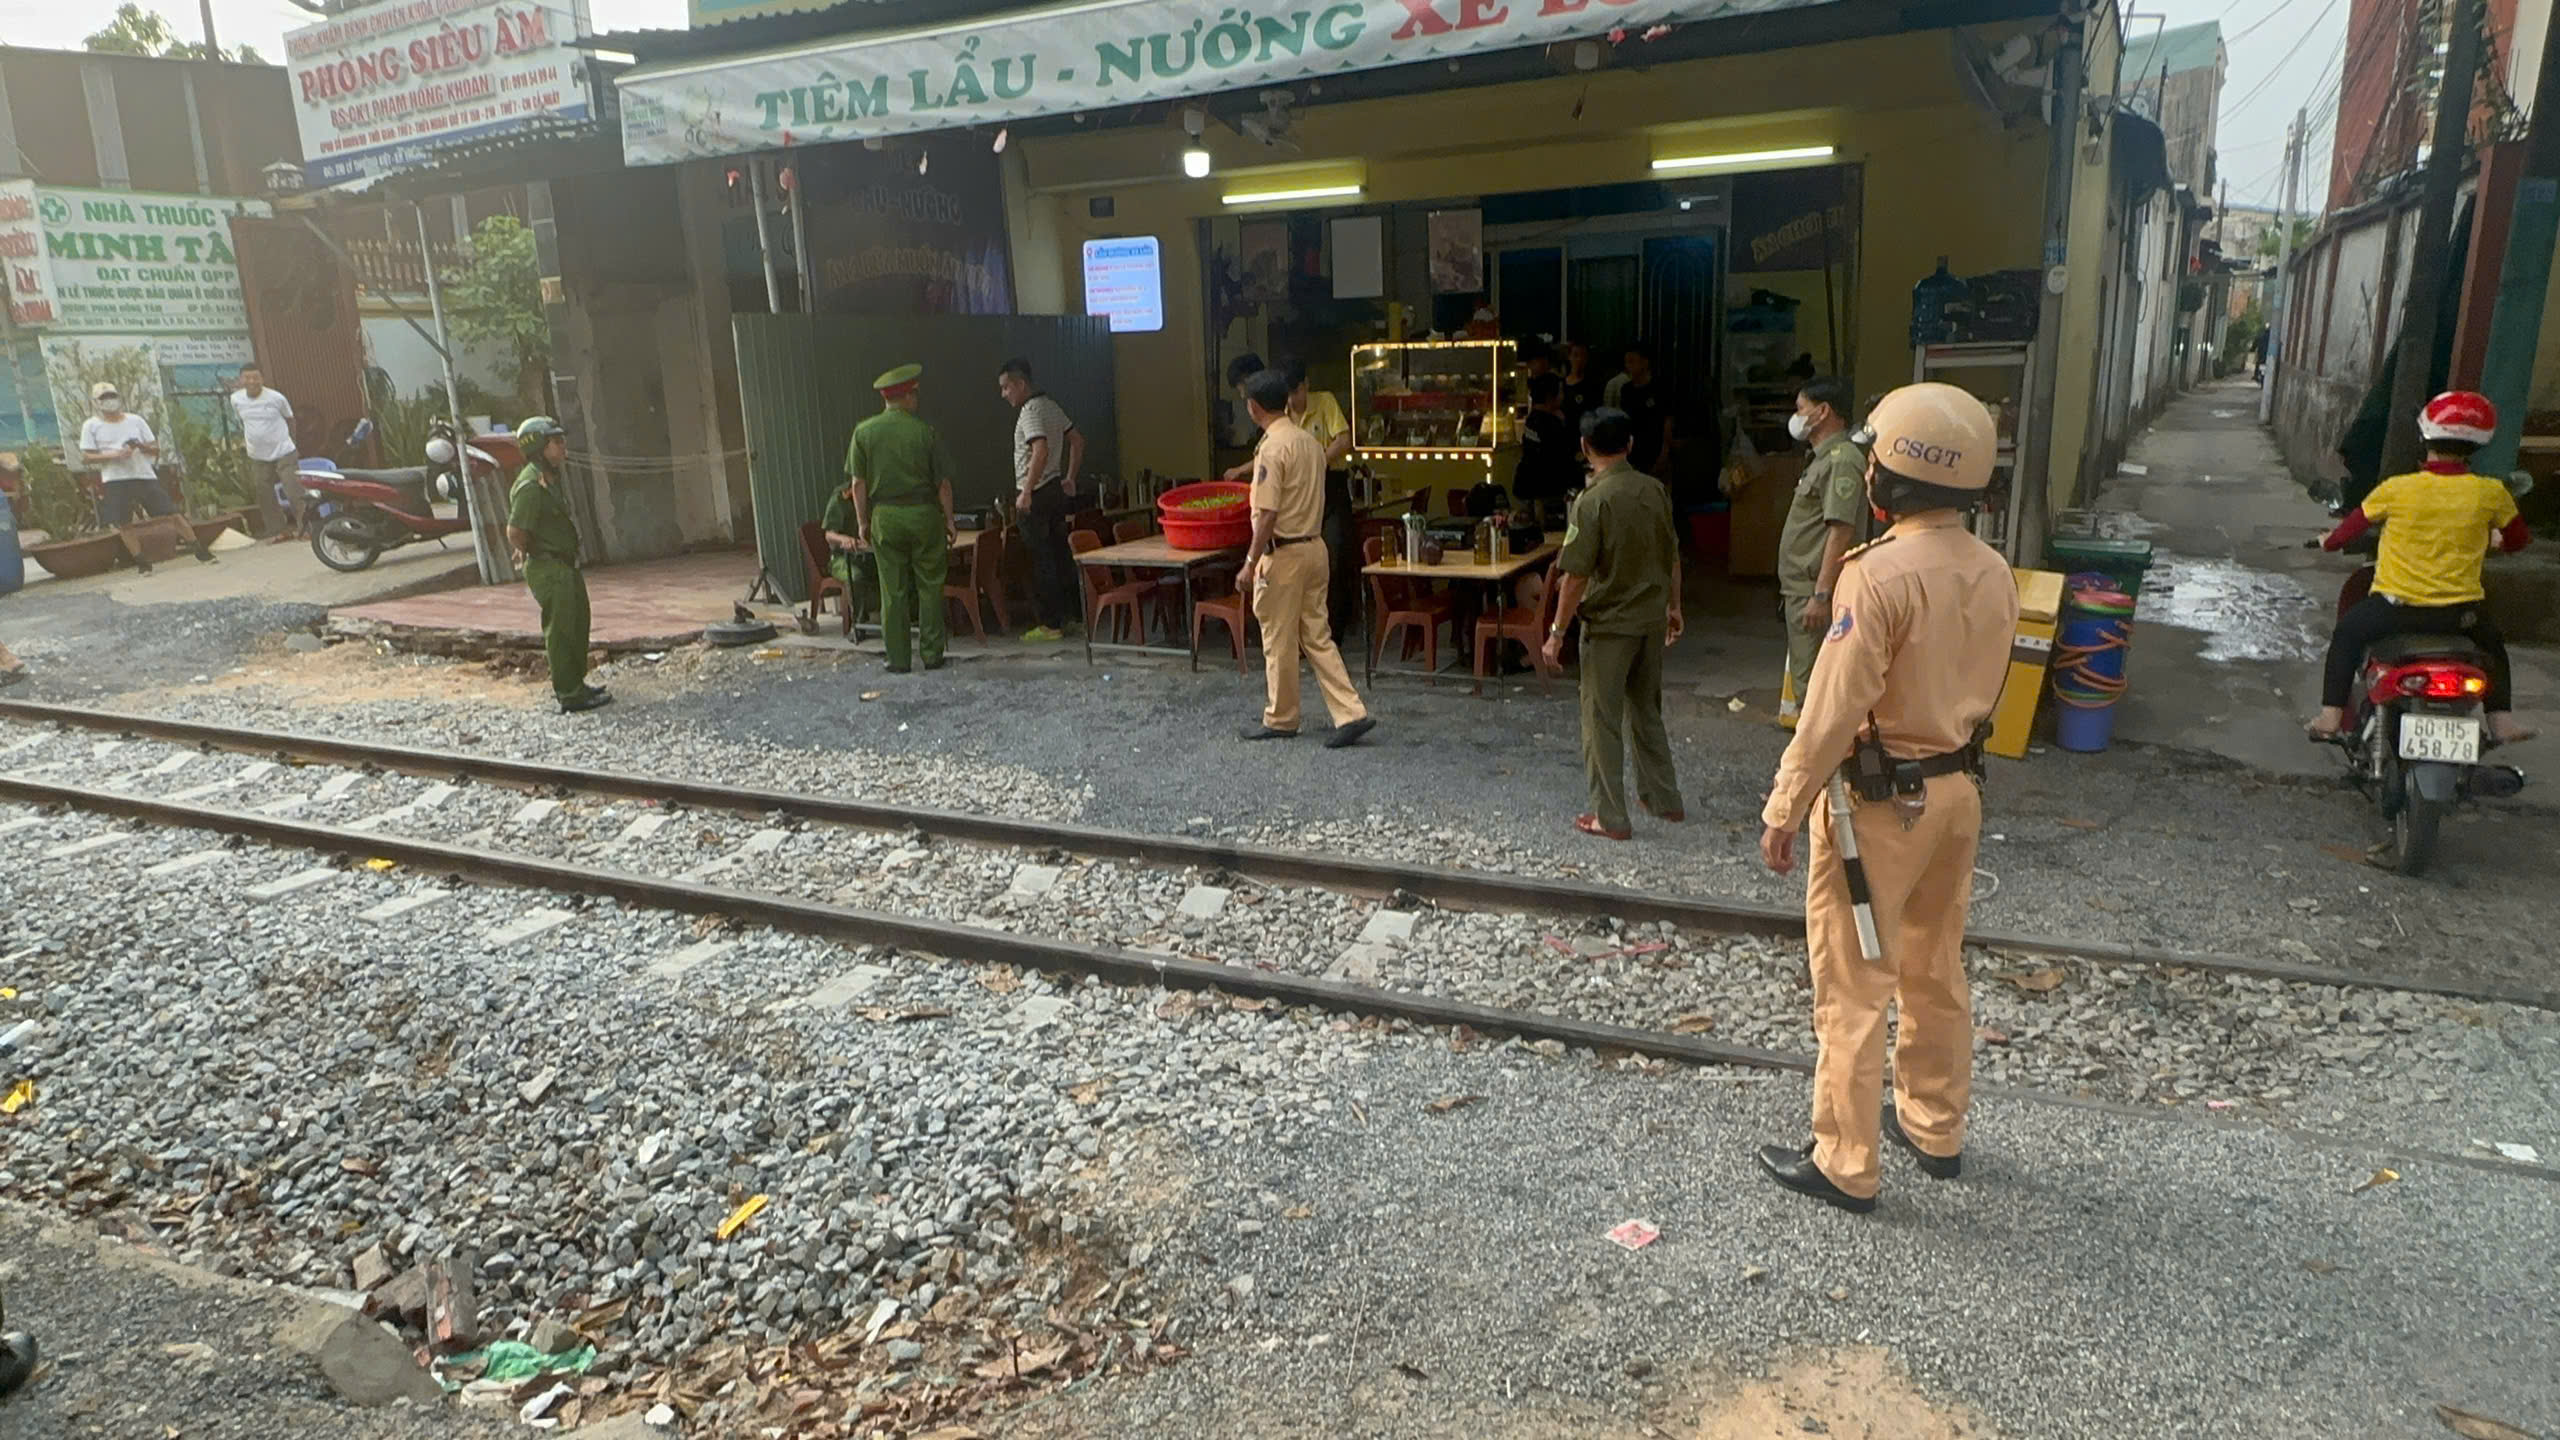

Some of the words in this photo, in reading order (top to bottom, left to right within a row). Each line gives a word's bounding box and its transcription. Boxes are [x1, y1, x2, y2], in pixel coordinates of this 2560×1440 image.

[298, 48, 402, 103] PHÒNG
[408, 21, 484, 75] SIÊU
[494, 5, 547, 55] ÂM
[907, 35, 1037, 112] LẨU
[1094, 3, 1367, 87] NƯỚNG
[1391, 0, 1510, 41] XE
[82, 199, 137, 225] NHÀ
[141, 200, 217, 227] THUỐC
[45, 230, 168, 262] MINH
[174, 230, 238, 264] TÂ
[137, 263, 196, 283] CHUẨN
[1892, 436, 1962, 469] CSGT
[2406, 737, 2474, 760] 458.78
